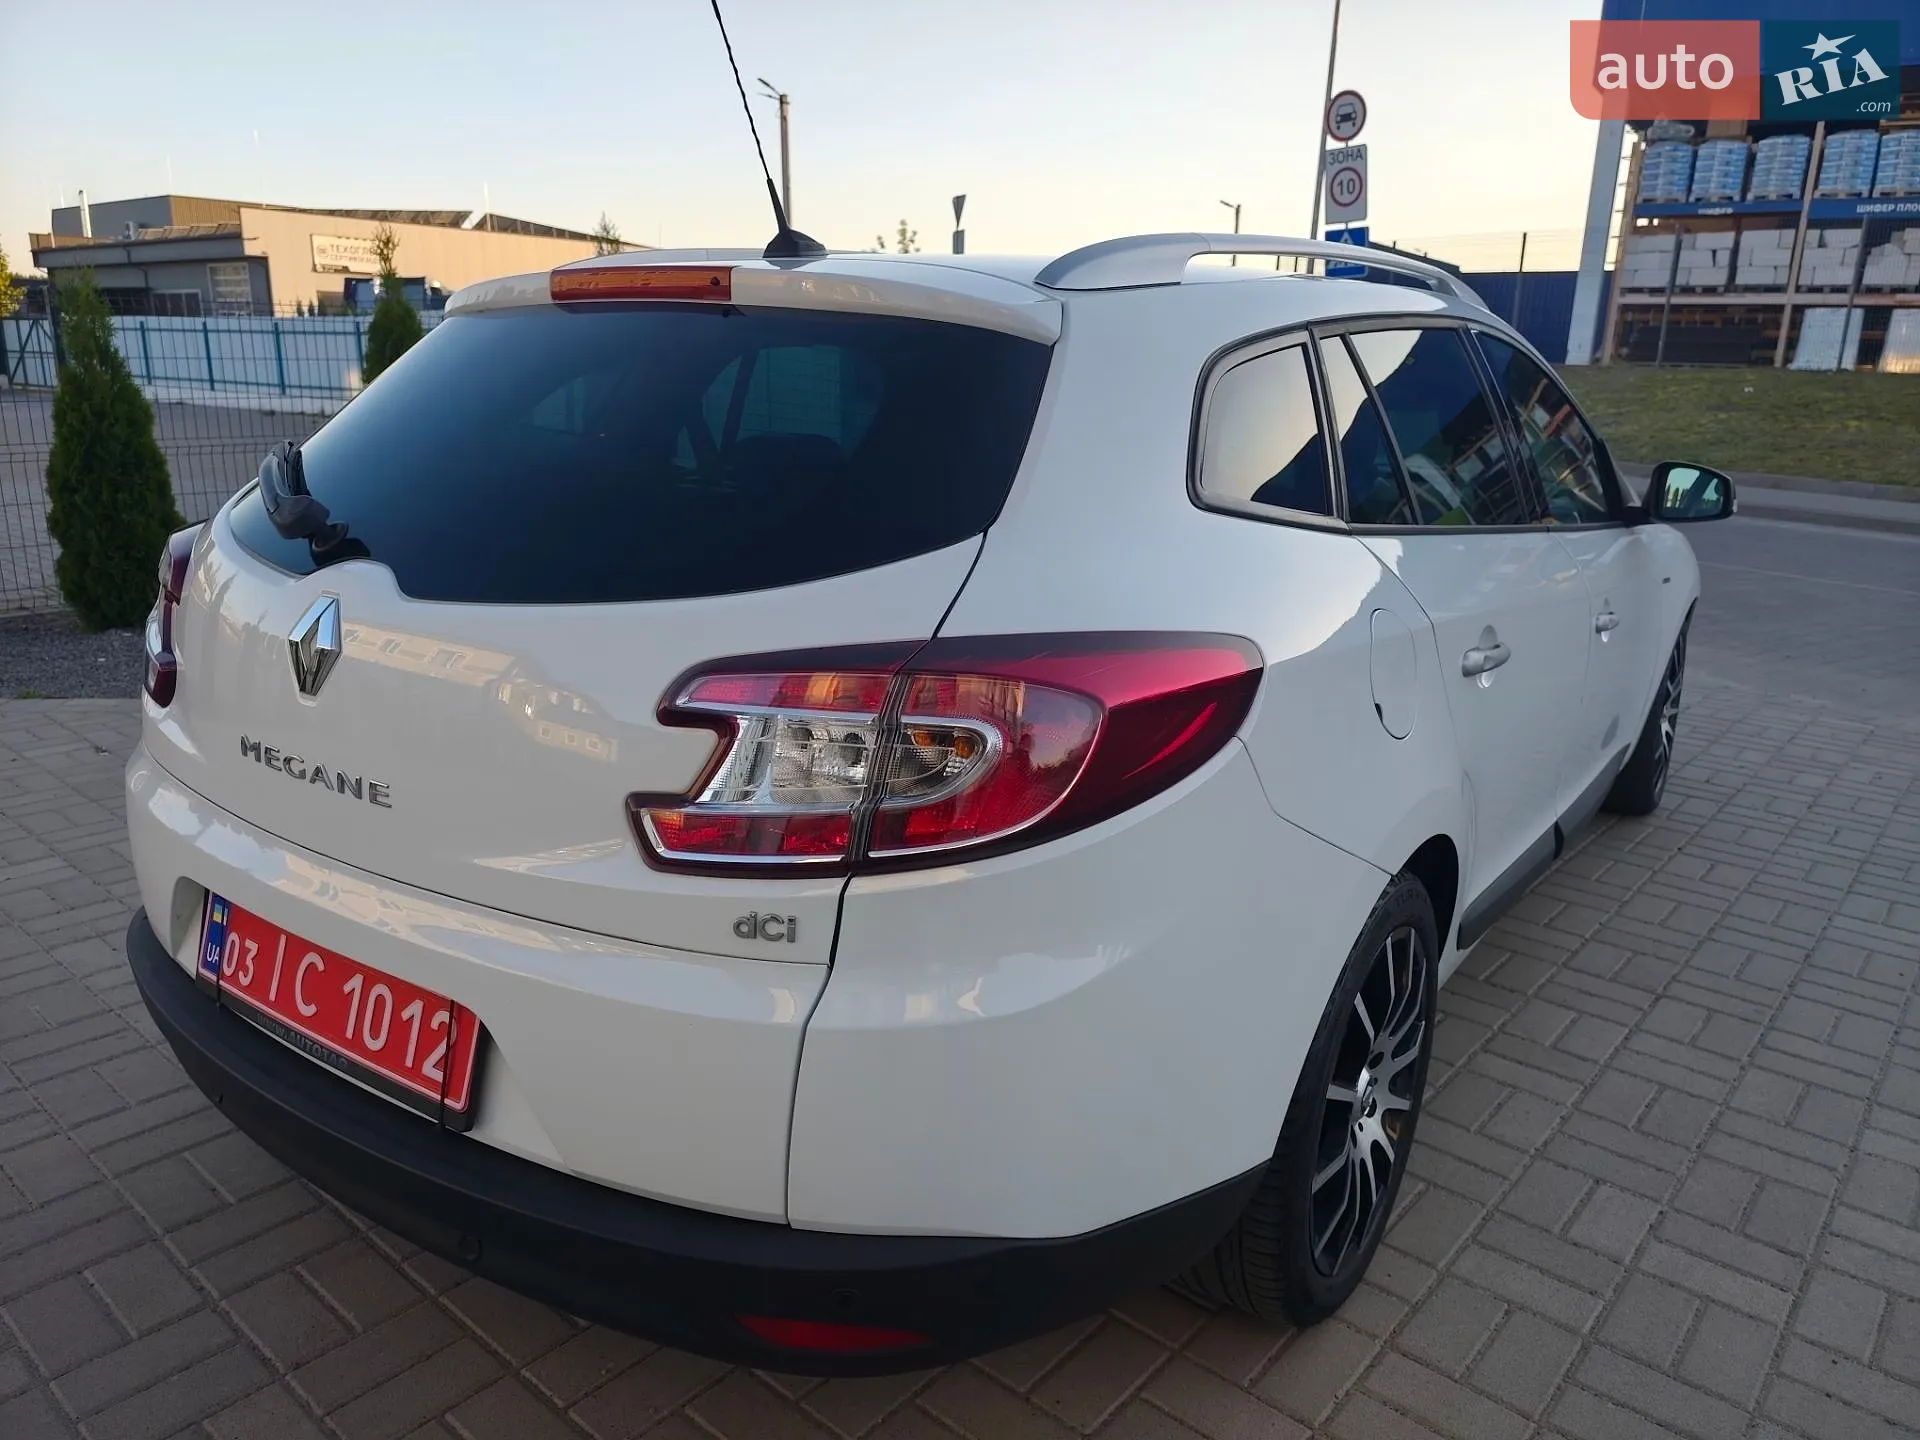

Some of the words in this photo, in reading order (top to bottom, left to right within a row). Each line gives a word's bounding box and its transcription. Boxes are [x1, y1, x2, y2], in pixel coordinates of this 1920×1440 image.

[1328, 148, 1364, 166] ЗОНА
[1336, 178, 1356, 197] 10
[1895, 202, 1920, 213] ПЛО
[240, 733, 394, 809] MEGANE
[732, 911, 797, 943] dCi
[206, 942, 220, 966] UA
[222, 931, 259, 987] 03
[343, 973, 458, 1084] 1012
